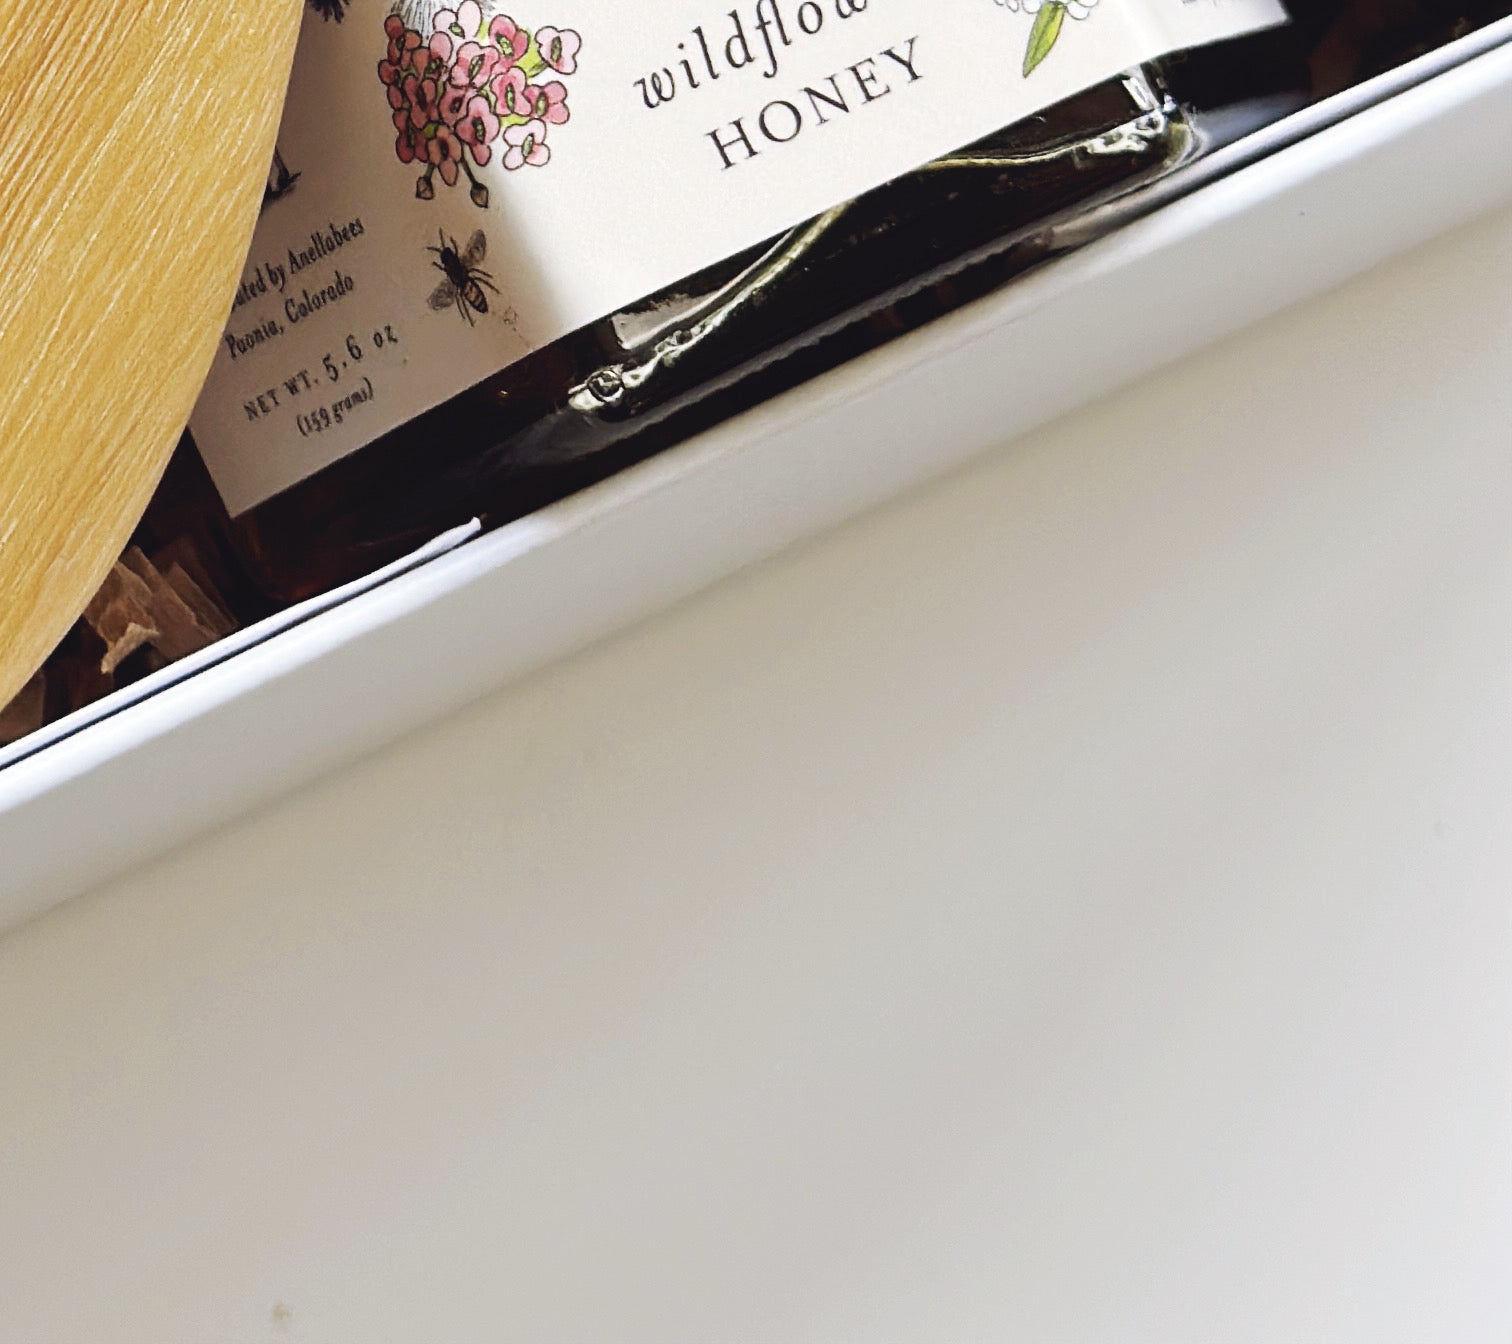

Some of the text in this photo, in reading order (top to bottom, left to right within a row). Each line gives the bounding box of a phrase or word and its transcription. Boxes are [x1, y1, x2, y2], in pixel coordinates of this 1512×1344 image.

[704, 35, 926, 172] HONEY
[265, 261, 287, 293] by
[287, 217, 366, 275] Anellabees
[224, 269, 354, 360] Paonia, Colorado
[243, 324, 399, 423] NET WT. 5.6 oz
[330, 375, 375, 426] grams)
